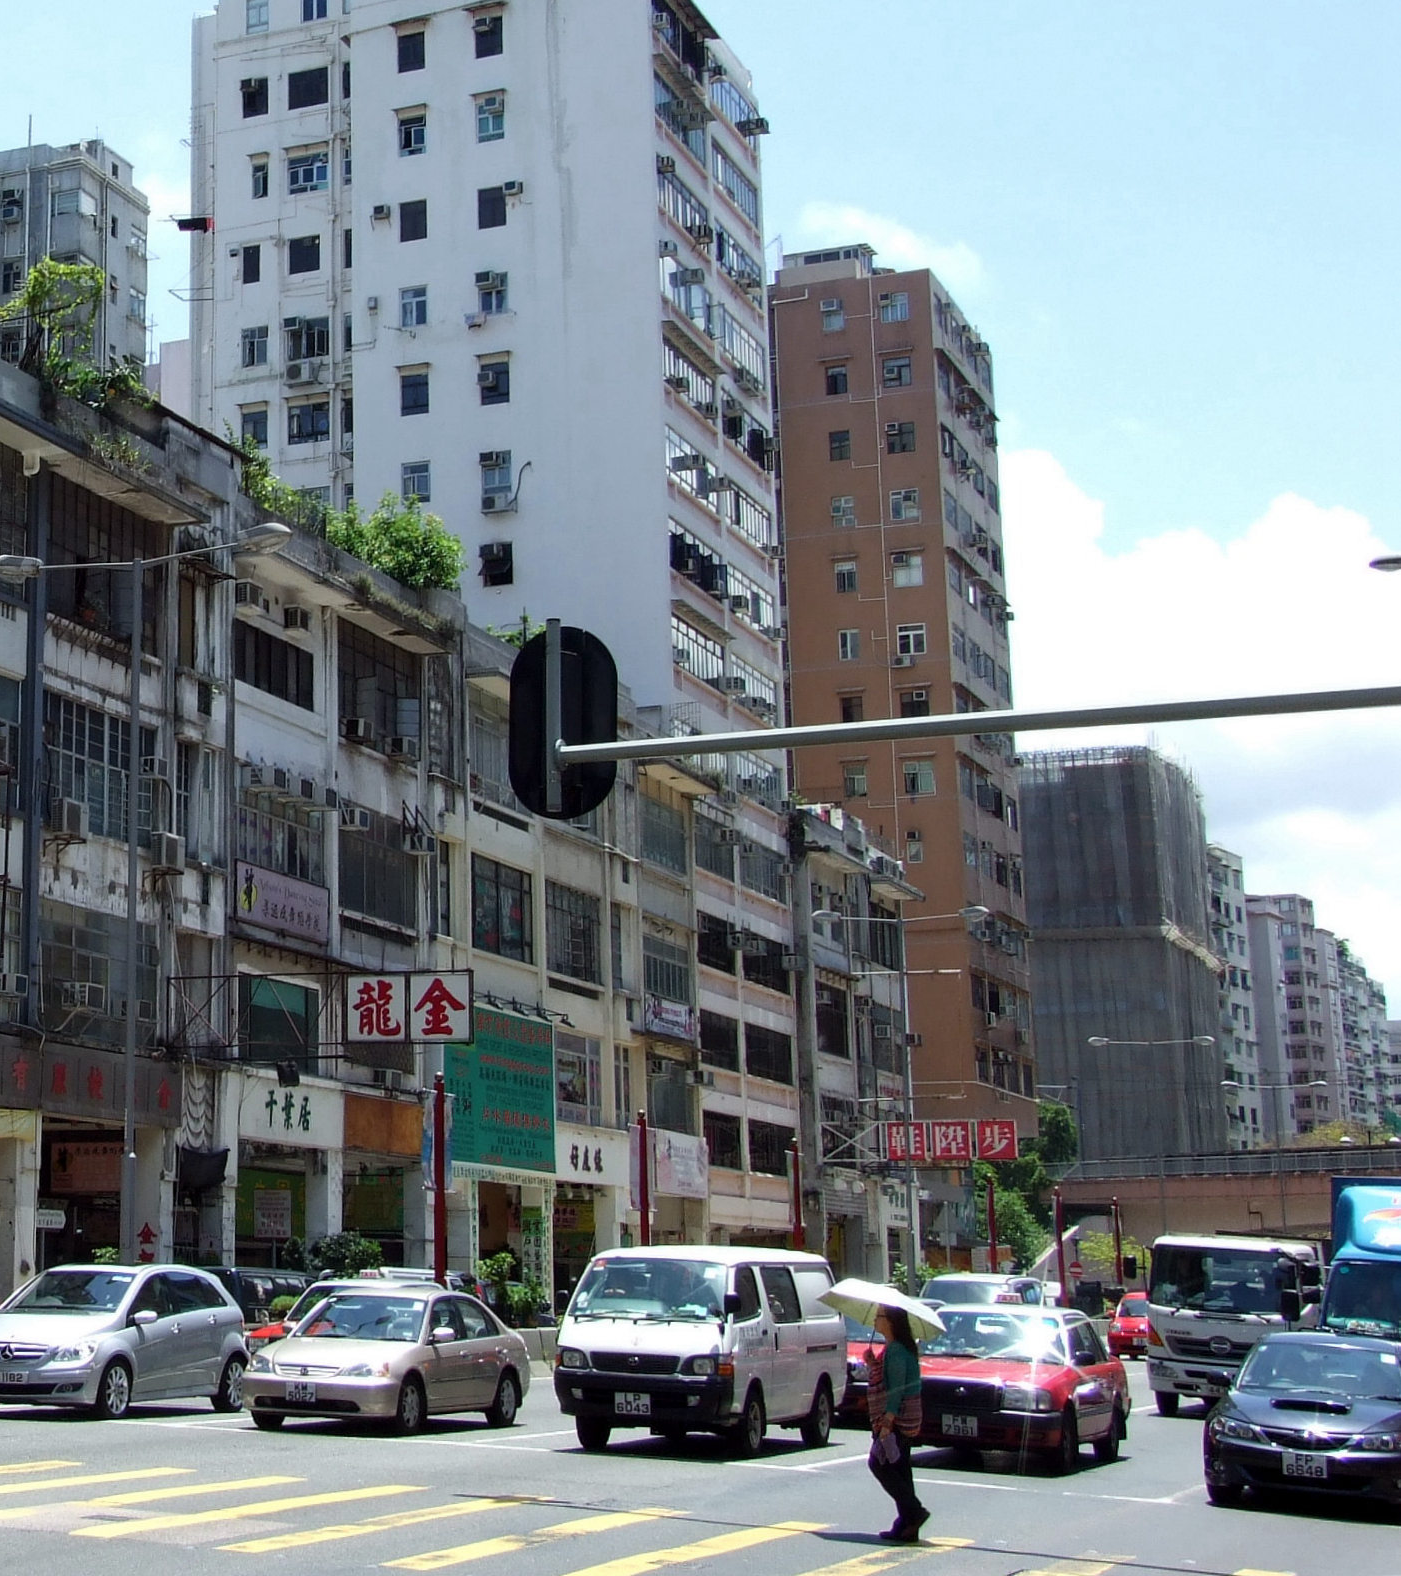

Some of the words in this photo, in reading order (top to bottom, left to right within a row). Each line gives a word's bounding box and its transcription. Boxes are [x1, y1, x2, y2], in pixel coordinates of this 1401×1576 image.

[624, 1393, 641, 1403] LP
[616, 1402, 649, 1414] 6043
[1295, 1453, 1313, 1465] FP
